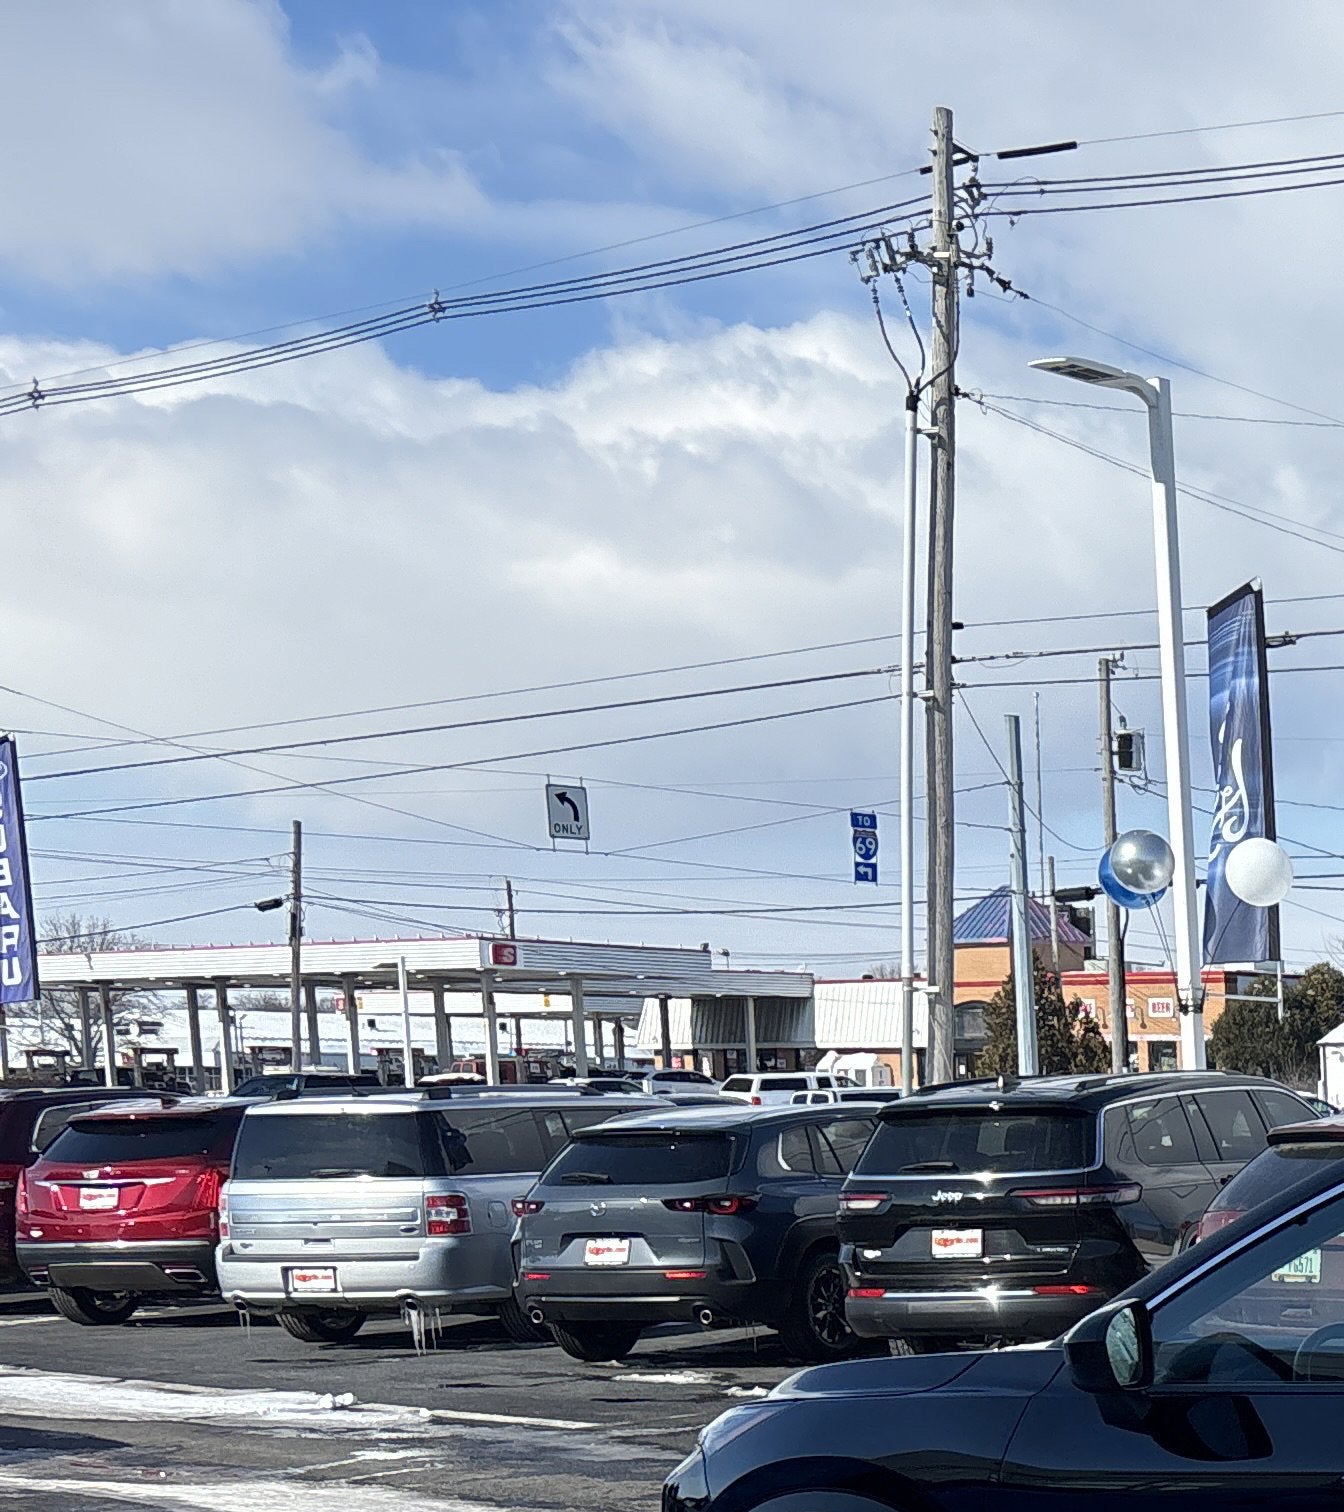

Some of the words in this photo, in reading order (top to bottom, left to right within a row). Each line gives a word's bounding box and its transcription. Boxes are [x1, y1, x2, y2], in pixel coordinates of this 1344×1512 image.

[856, 815, 871, 827] TO
[553, 823, 583, 835] ONLY
[855, 837, 876, 855] 69
[1151, 1002, 1171, 1013] BEER
[931, 1190, 963, 1204] Jeep
